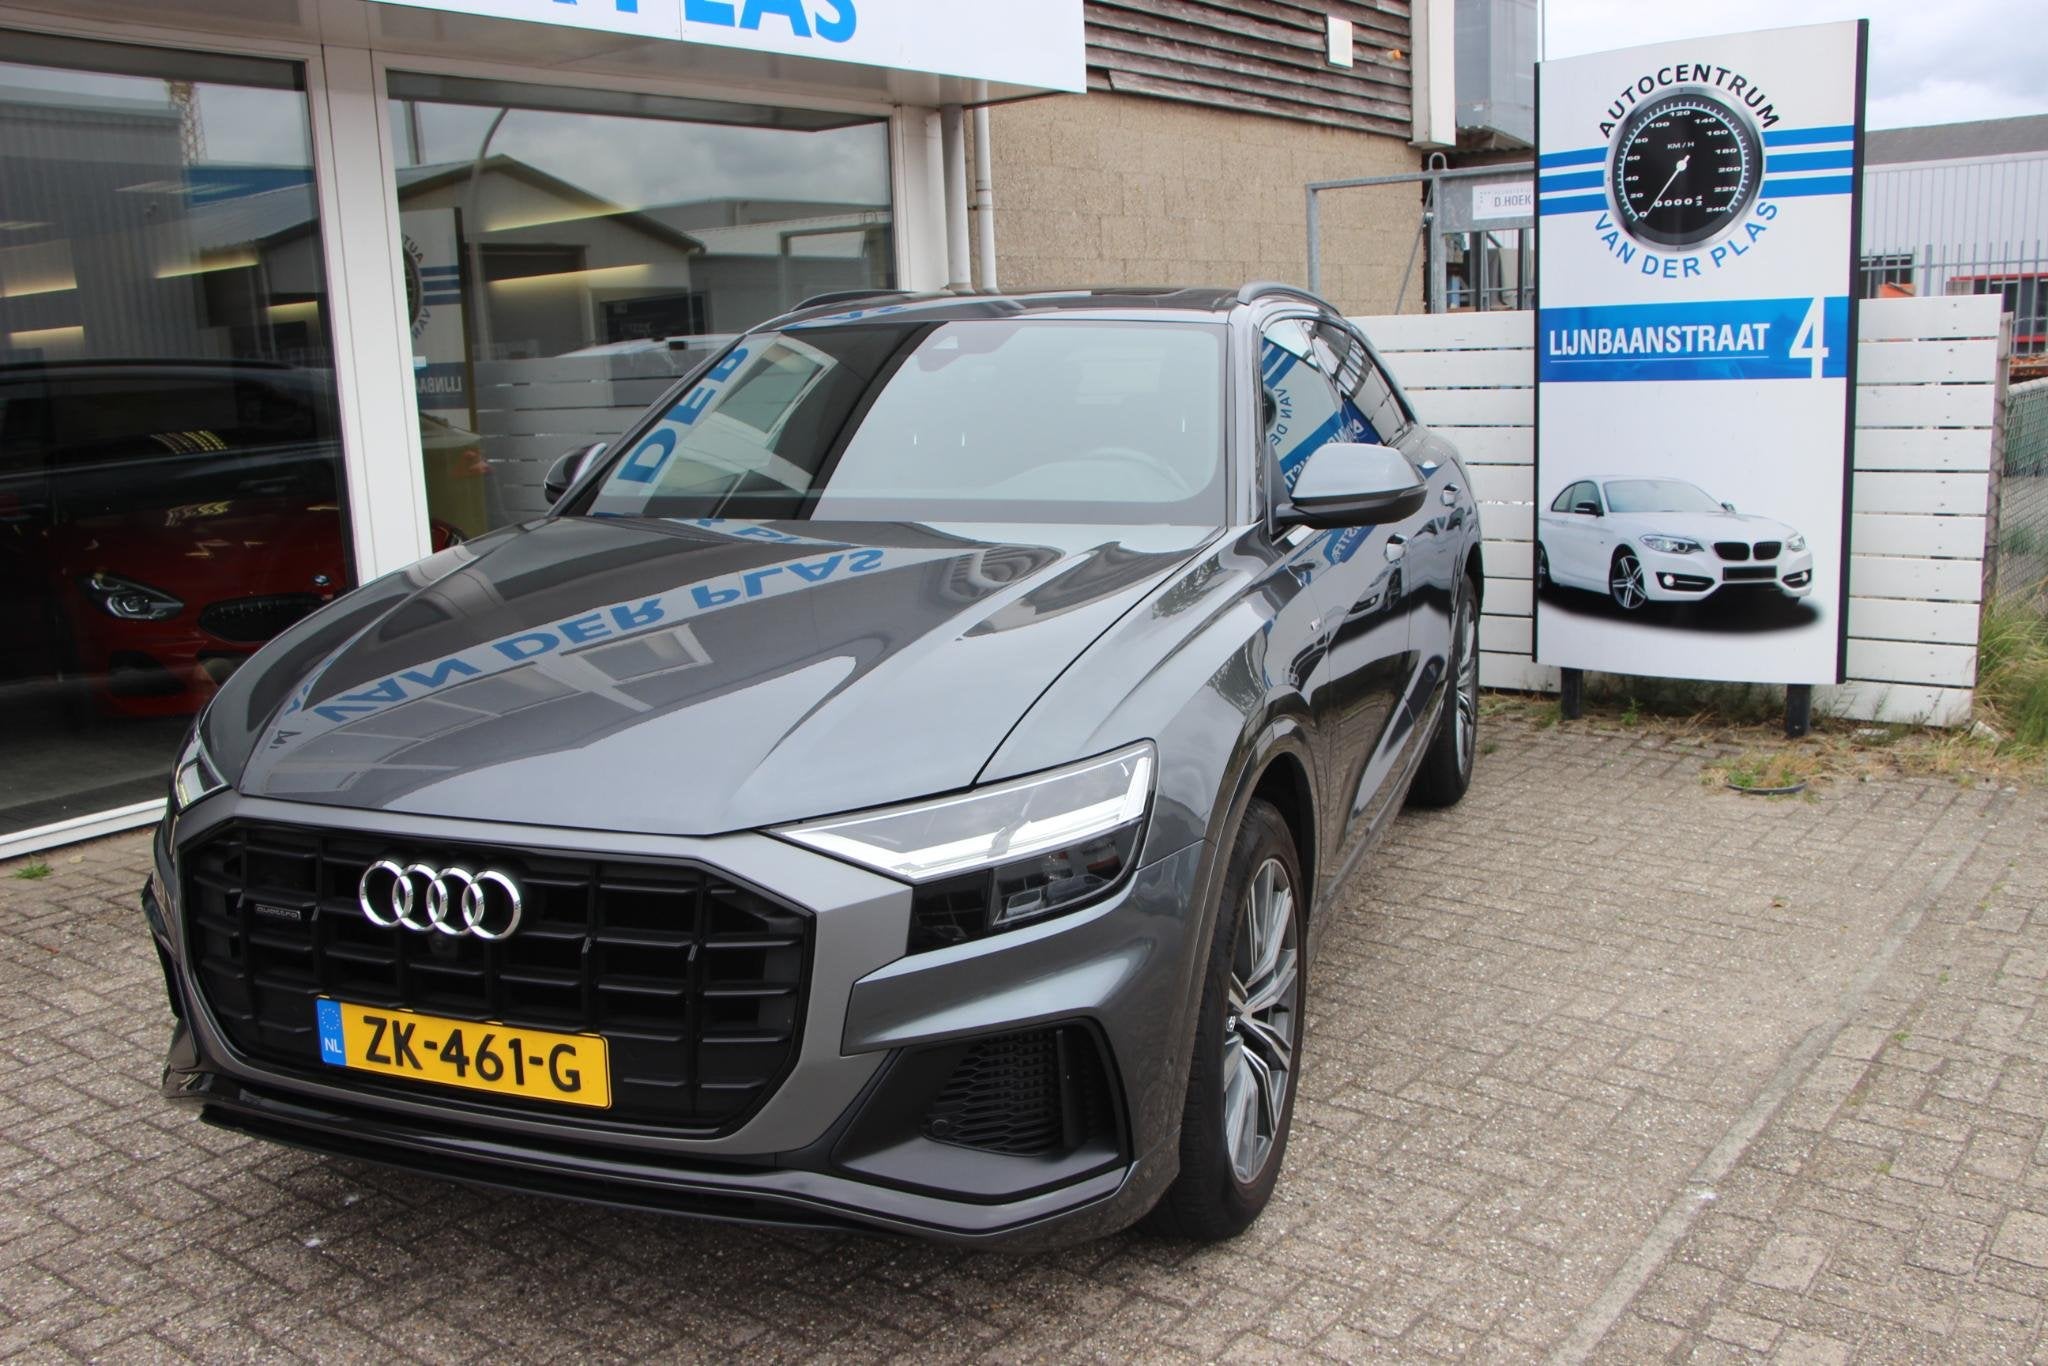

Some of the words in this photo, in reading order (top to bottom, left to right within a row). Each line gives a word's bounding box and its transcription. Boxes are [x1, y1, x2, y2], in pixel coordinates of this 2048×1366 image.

[1599, 64, 1780, 138] AUTOCENTRUM
[1594, 212, 1637, 264] VAN
[1641, 255, 1701, 279] DER
[1711, 201, 1778, 268] PLAS
[1549, 323, 1771, 356] LIJNBAANSTRAAT
[1788, 297, 1829, 379] 4
[324, 1037, 342, 1054] NL
[362, 1014, 582, 1093] ZK-461-G
